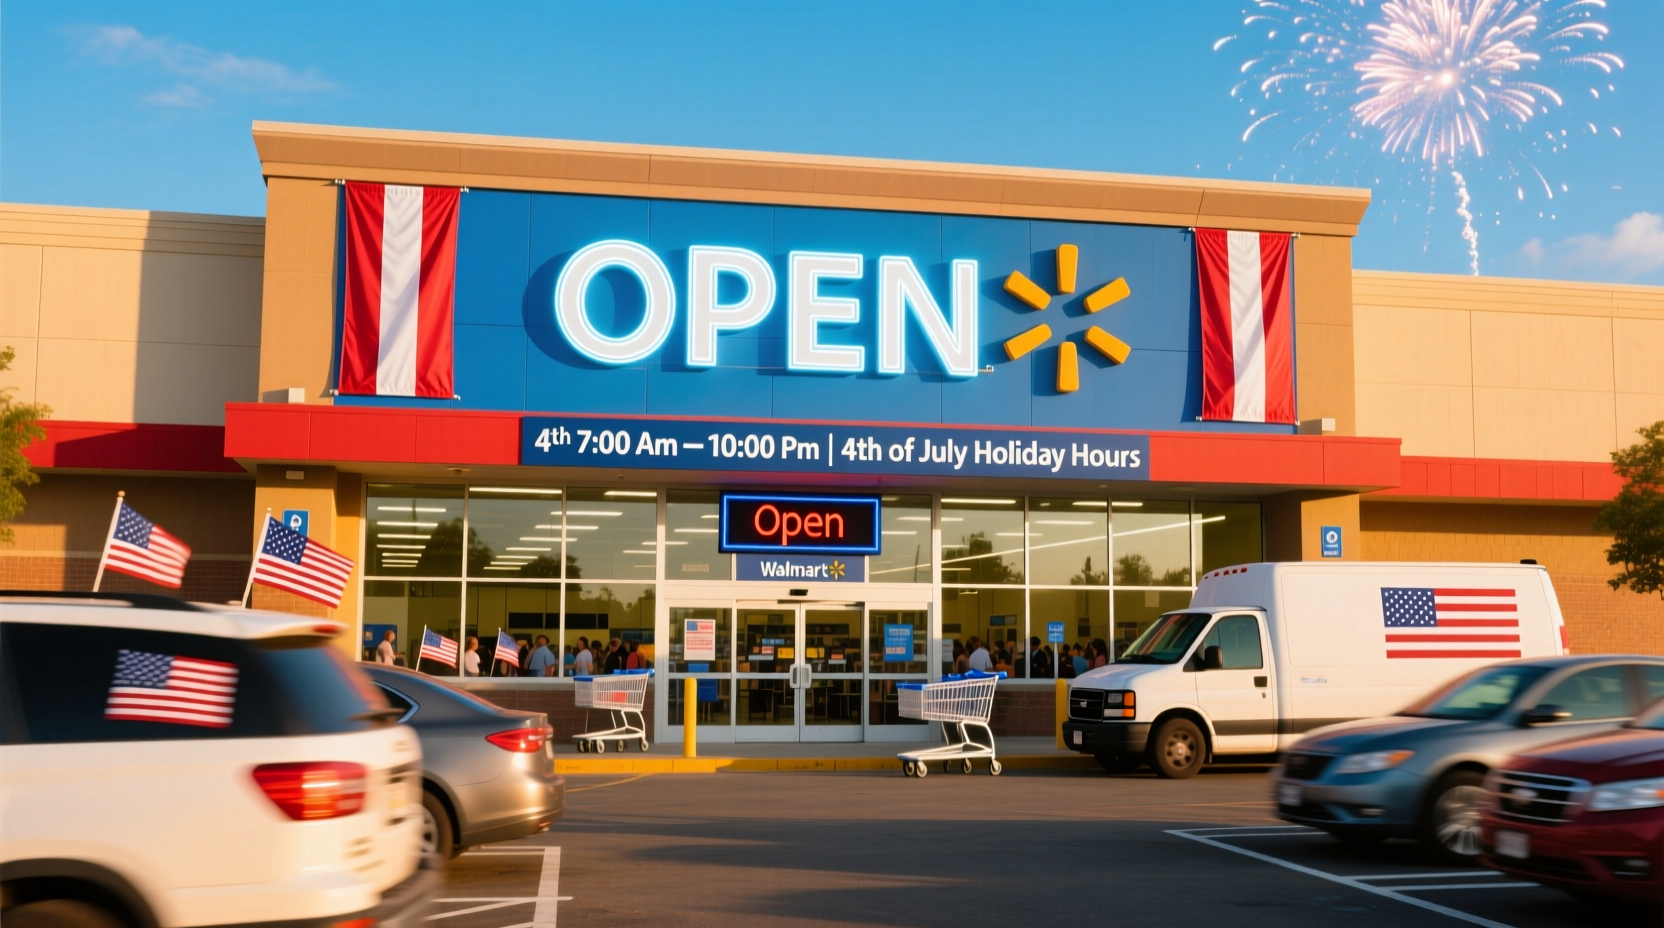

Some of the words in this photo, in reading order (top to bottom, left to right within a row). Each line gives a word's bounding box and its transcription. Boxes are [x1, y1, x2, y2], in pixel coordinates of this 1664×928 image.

[554, 239, 978, 377] OPEN
[534, 426, 571, 453] 4th
[576, 429, 631, 455] 7:00
[635, 431, 678, 457] Am
[707, 433, 776, 459] 10:00
[781, 435, 820, 460] Pm
[840, 436, 883, 462] 4th
[888, 436, 916, 463] of
[918, 438, 969, 470] July
[974, 439, 1066, 473] Holiday
[1071, 442, 1141, 469] Hours
[754, 503, 844, 547] Open
[760, 560, 829, 578] Walmart
